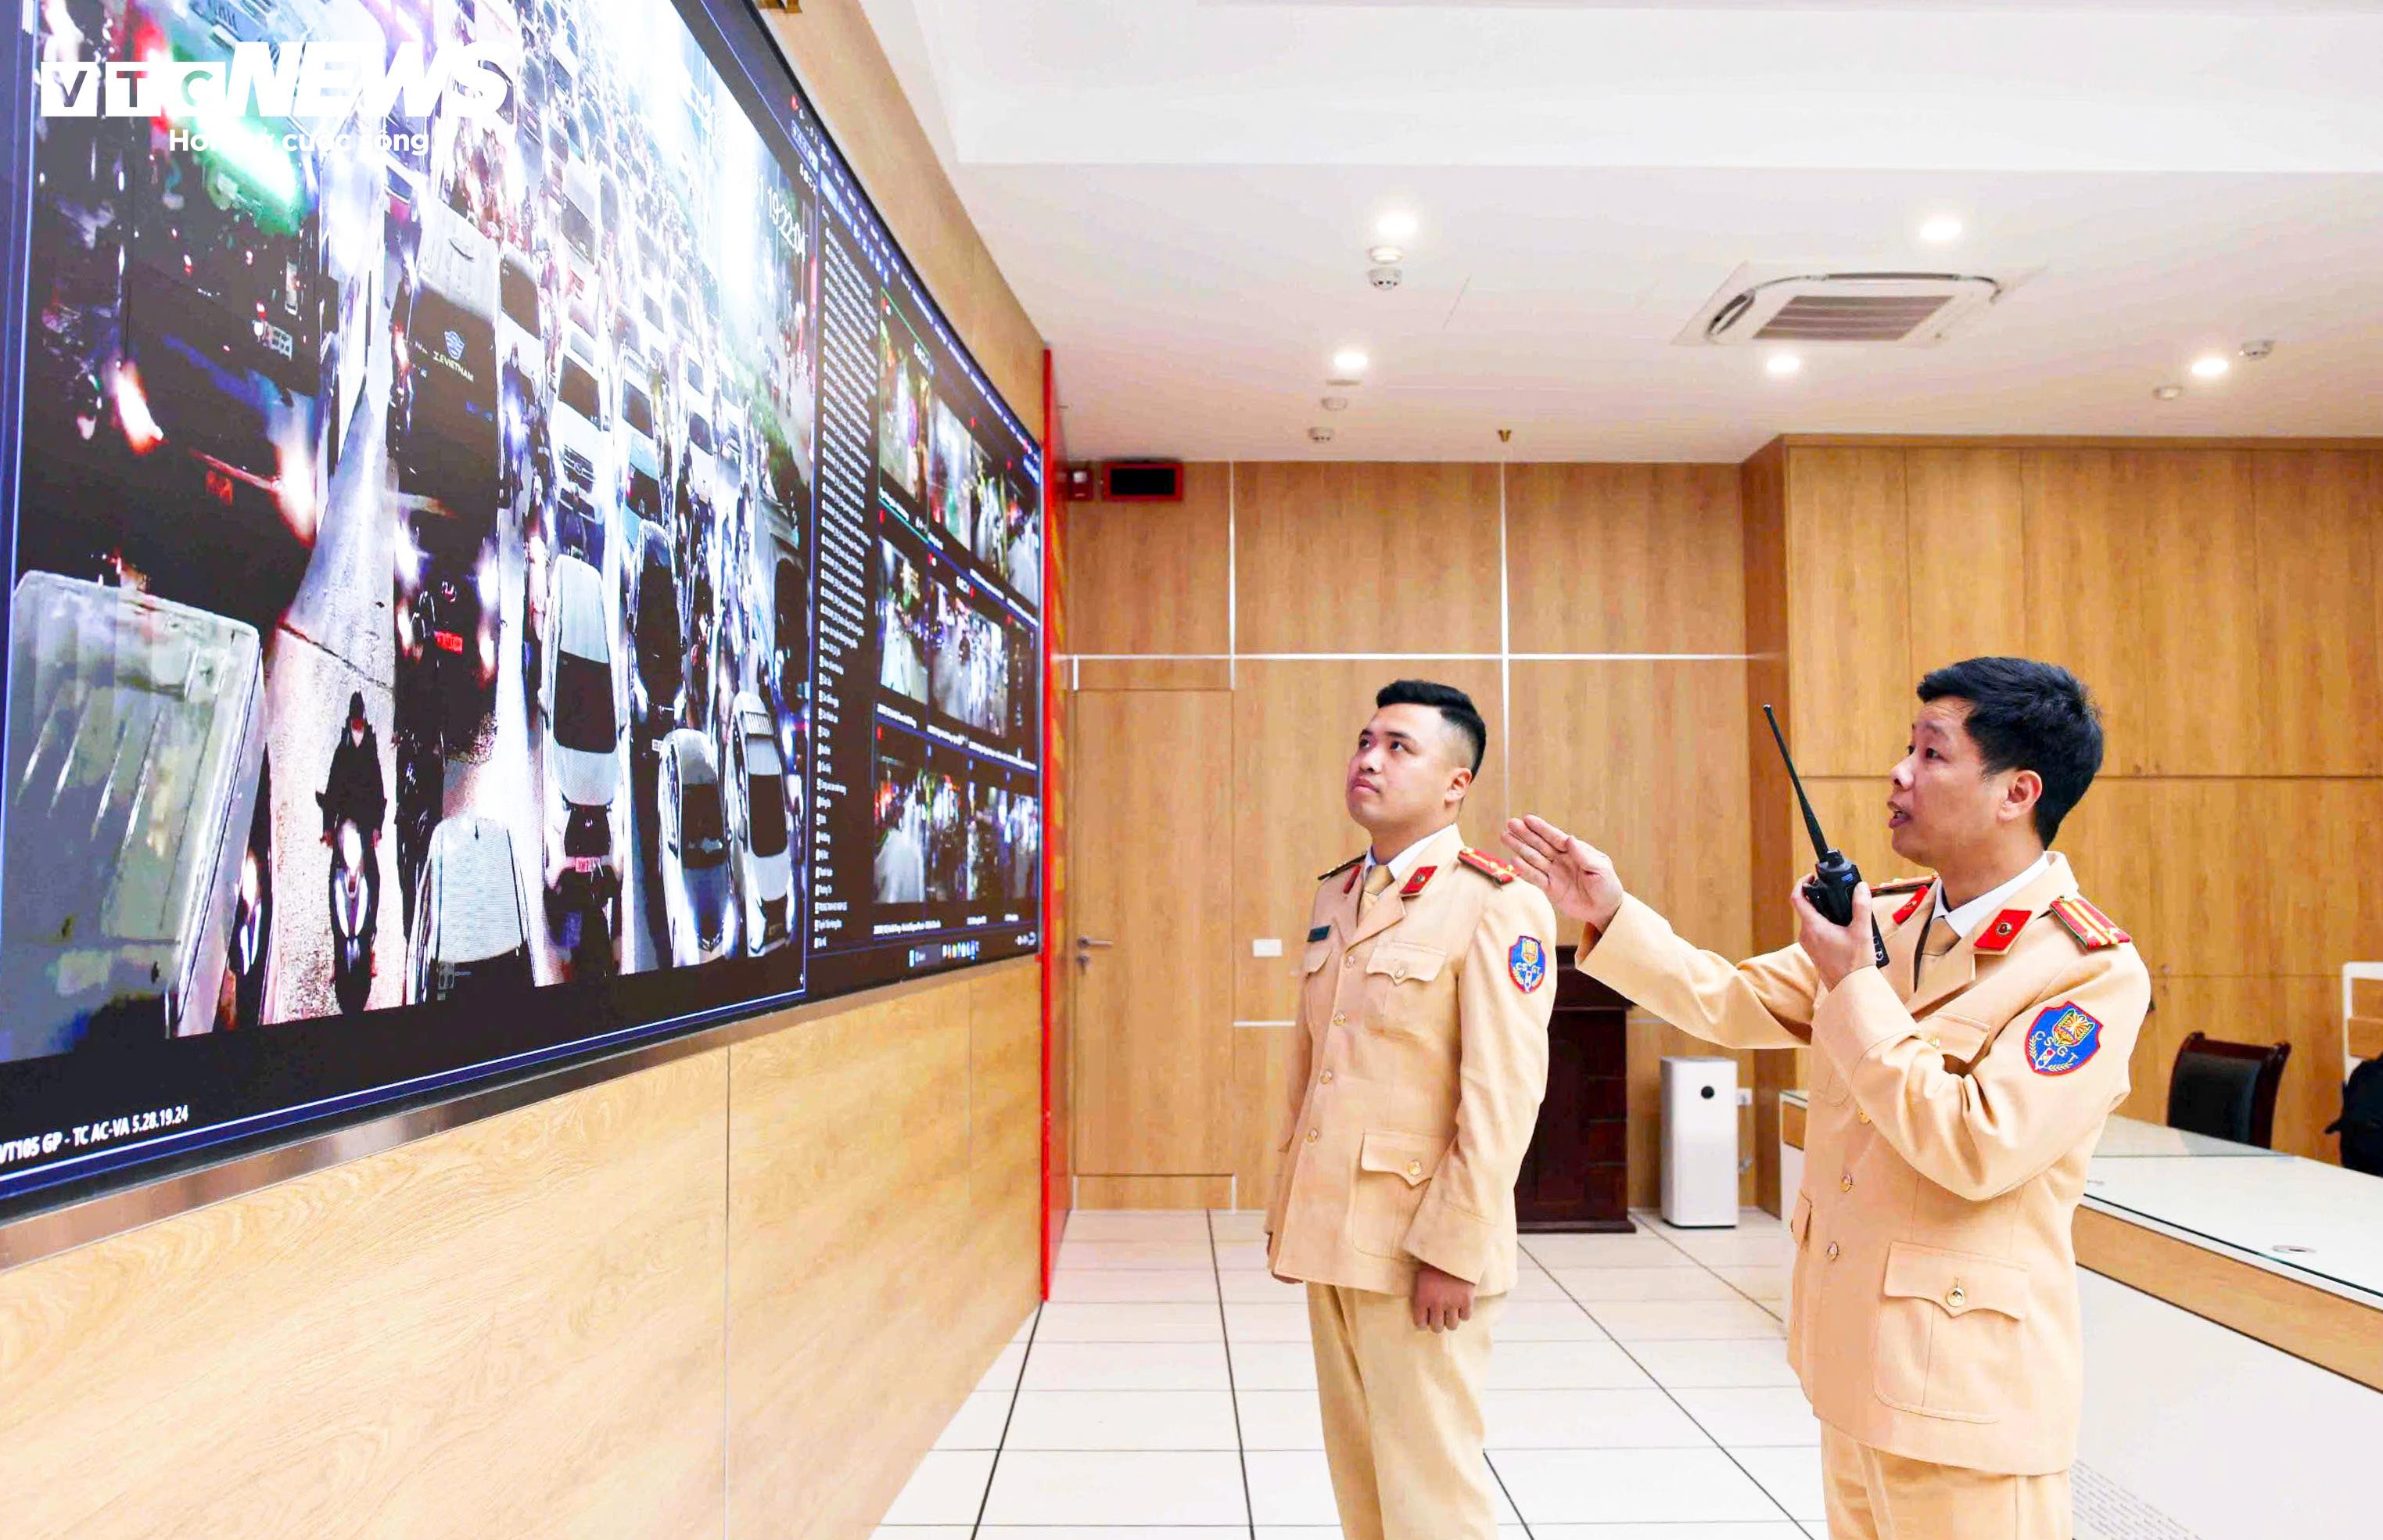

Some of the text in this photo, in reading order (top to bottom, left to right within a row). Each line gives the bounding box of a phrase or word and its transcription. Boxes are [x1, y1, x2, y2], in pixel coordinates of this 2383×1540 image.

[2034, 1030, 2079, 1063] CSGT
[42, 1131, 63, 1154] GP
[73, 1125, 89, 1147] TC
